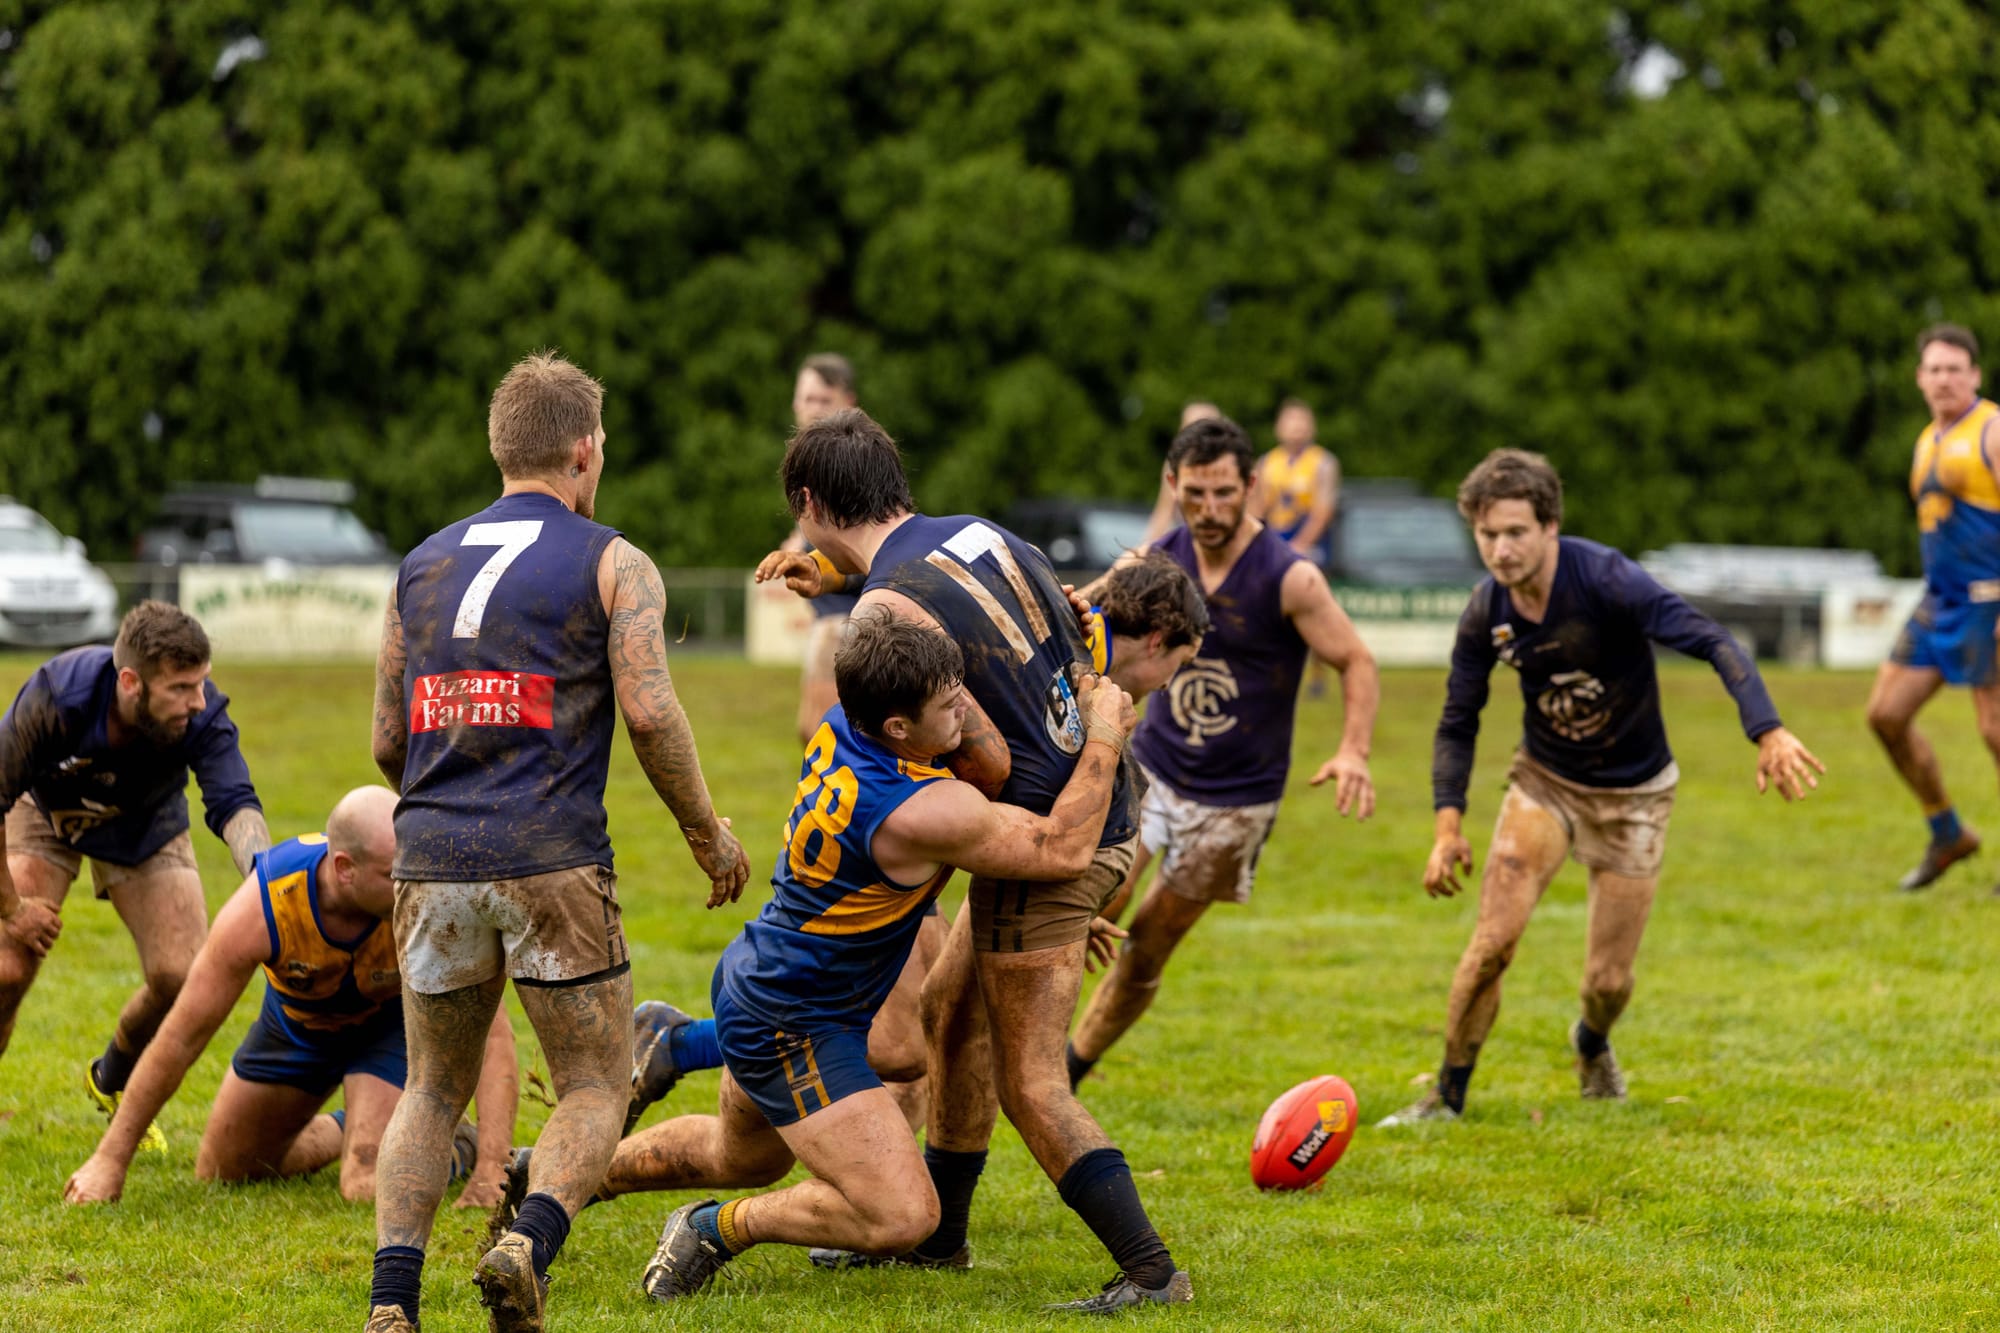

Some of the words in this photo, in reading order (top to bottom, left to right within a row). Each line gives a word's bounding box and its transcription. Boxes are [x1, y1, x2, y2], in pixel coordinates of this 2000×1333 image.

[452, 520, 544, 638] 7
[923, 521, 1052, 665] 17
[421, 673, 520, 698] Vizzarri
[421, 698, 521, 730] Farms
[1291, 1127, 1329, 1164] Work
